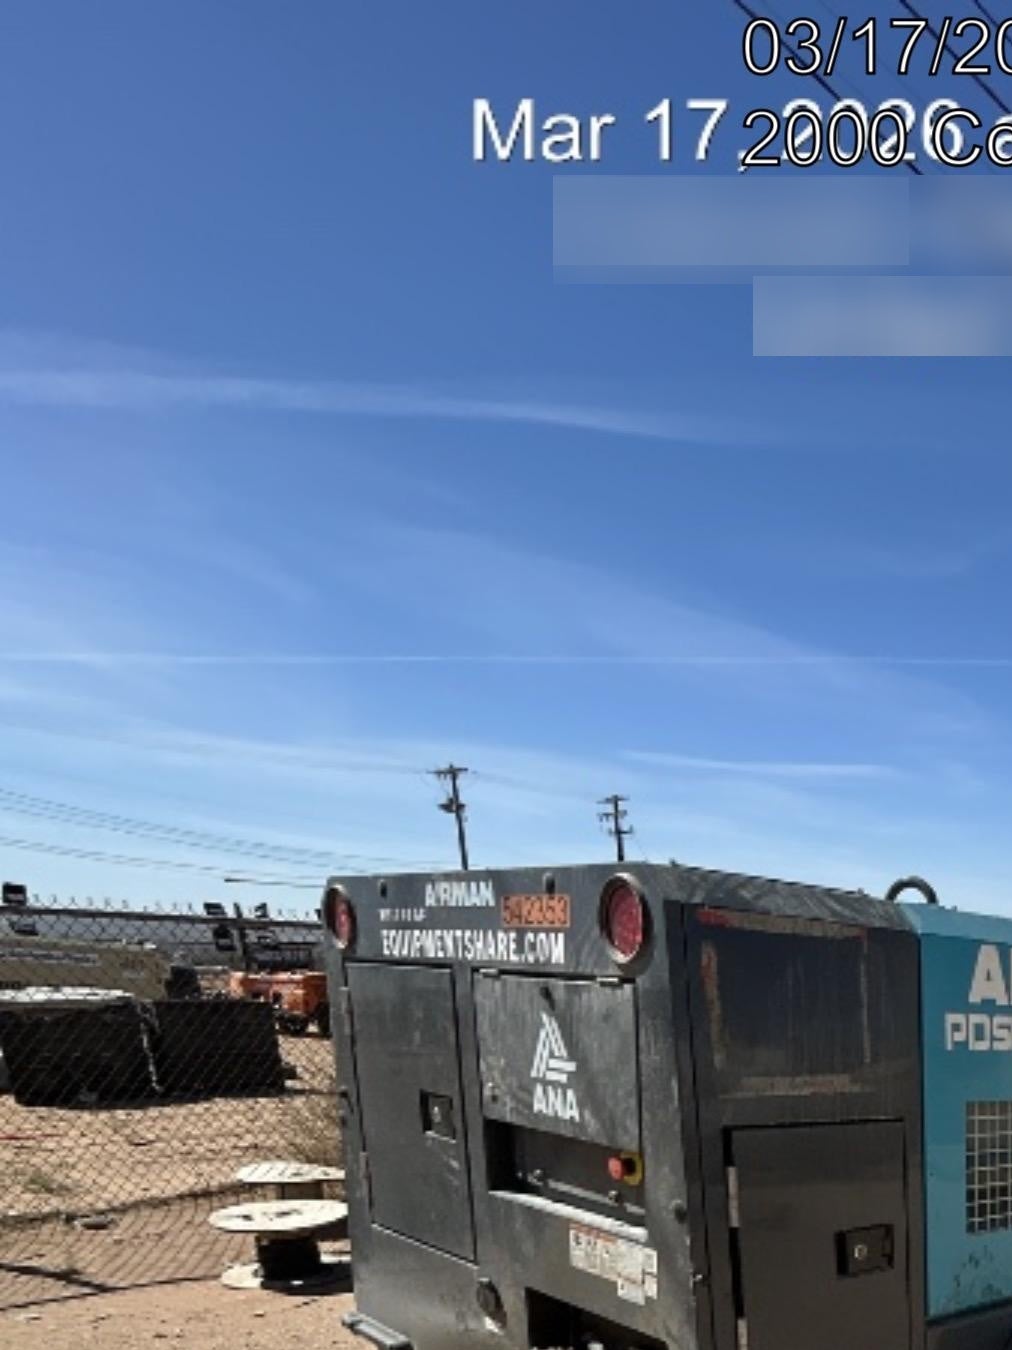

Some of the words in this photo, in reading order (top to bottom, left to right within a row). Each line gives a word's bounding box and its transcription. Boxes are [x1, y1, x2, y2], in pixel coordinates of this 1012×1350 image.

[424, 879, 496, 908] AIRMAN
[380, 929, 565, 965] EQUIPMENTSHARE.COM
[533, 1083, 580, 1122] ANA
